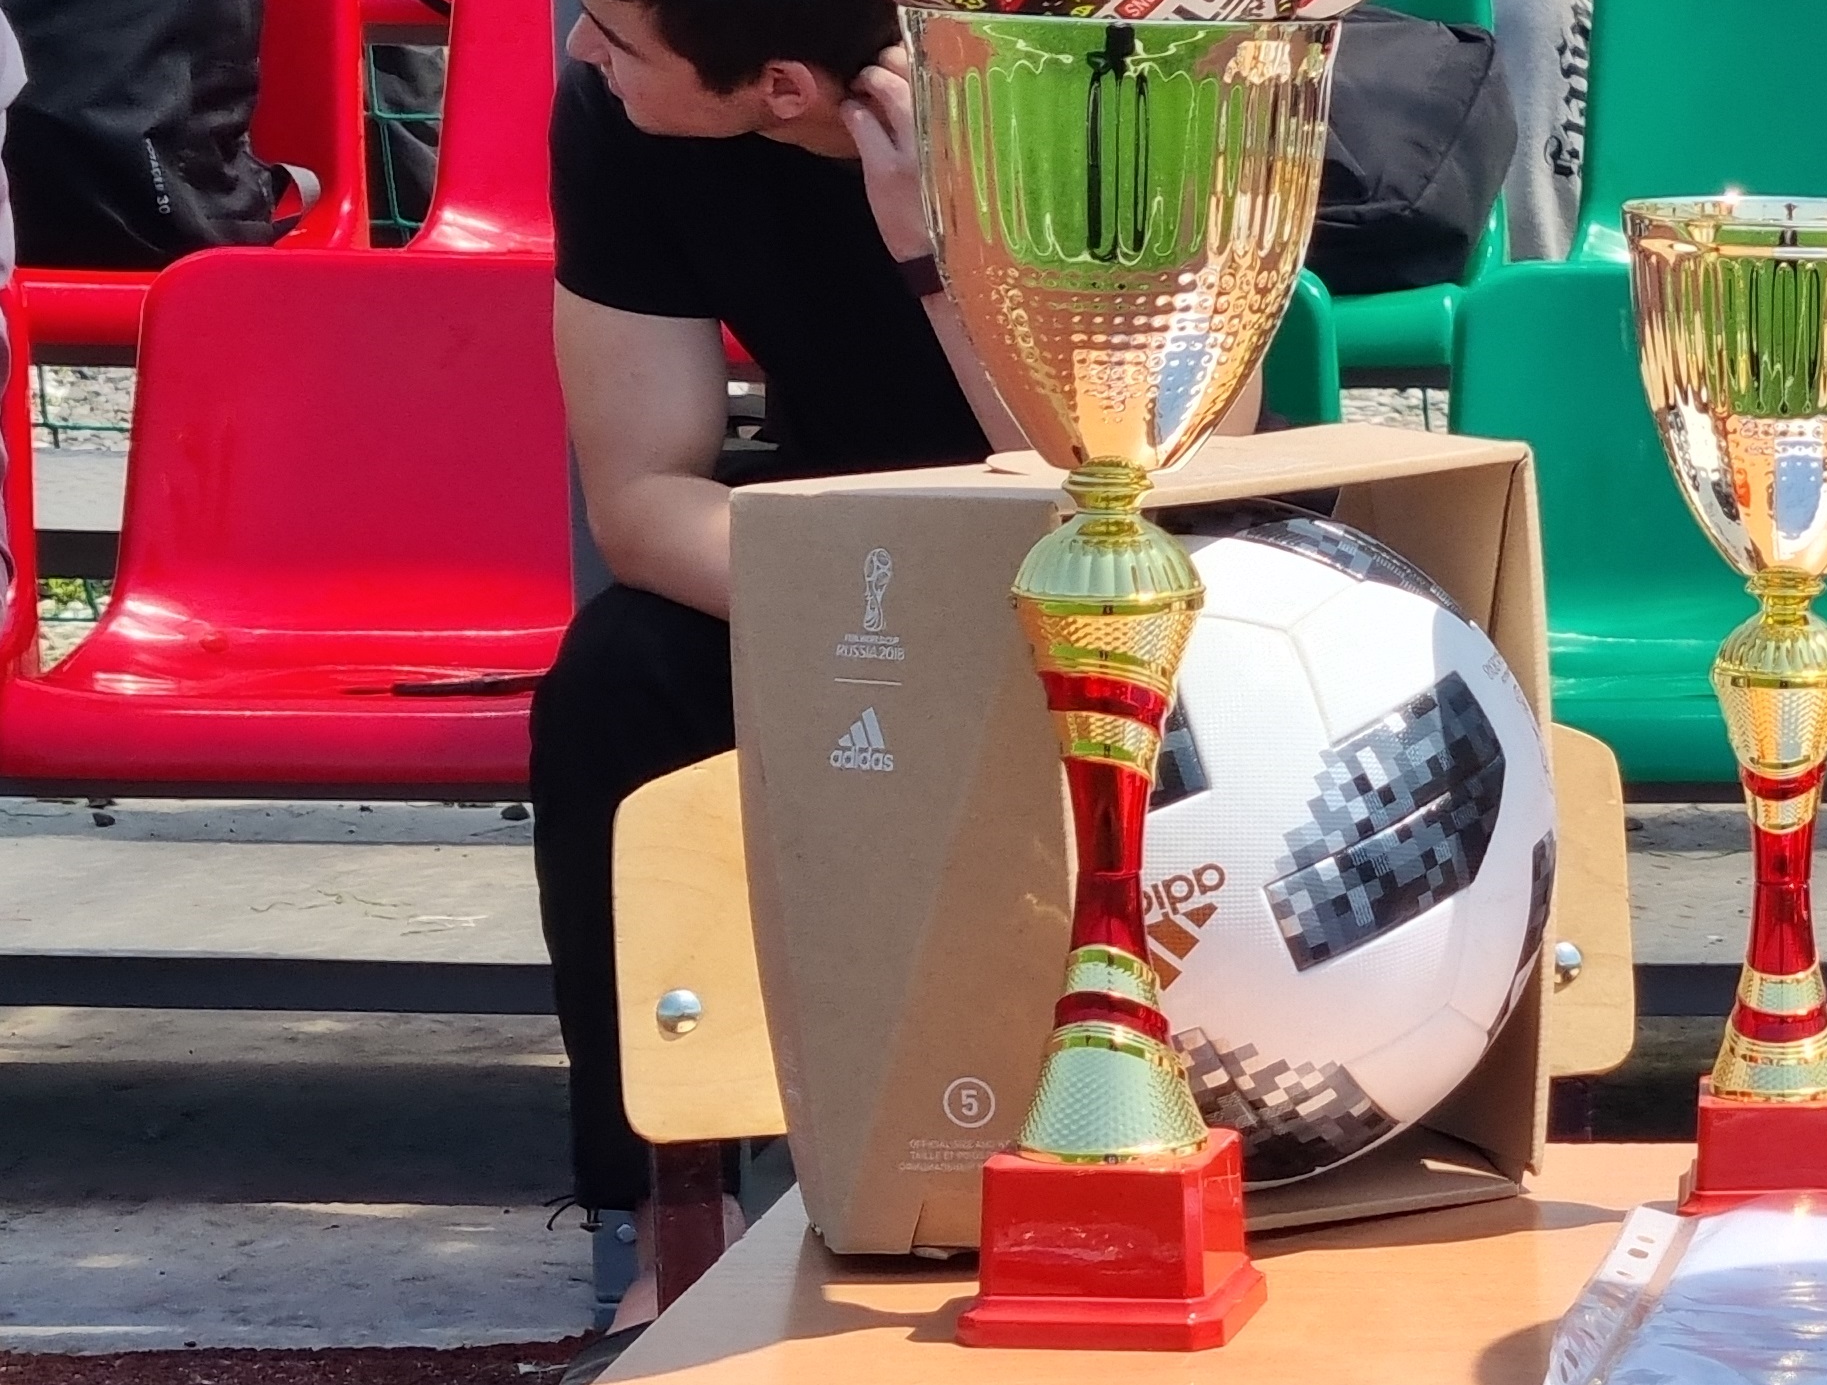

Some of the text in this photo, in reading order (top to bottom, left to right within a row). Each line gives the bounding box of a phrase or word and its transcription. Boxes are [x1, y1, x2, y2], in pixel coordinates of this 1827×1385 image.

[156, 194, 171, 214] 30
[836, 644, 878, 659] RUSSIA
[829, 746, 894, 772] adidas
[961, 1089, 979, 1116] 5
